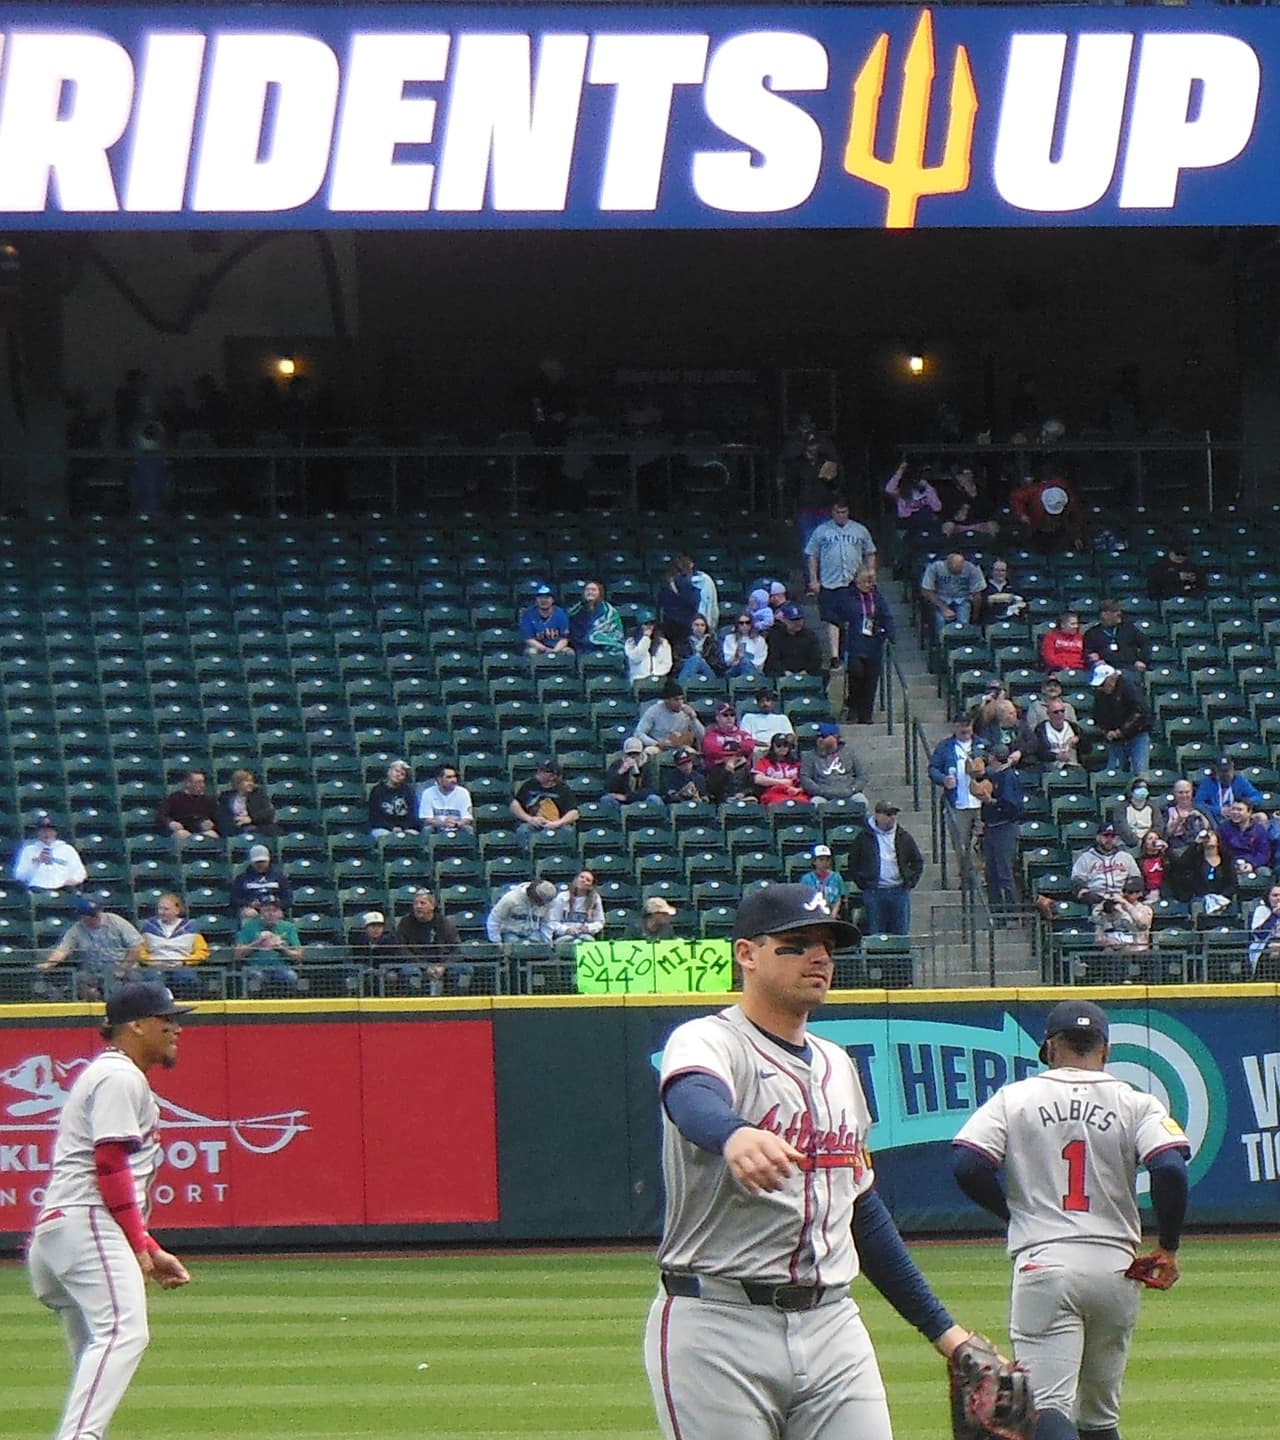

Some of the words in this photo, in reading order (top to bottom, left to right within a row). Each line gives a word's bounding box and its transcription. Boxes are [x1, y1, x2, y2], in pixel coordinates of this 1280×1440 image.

[0, 30, 830, 212] RIDENTS
[993, 31, 1262, 211] UP
[579, 944, 653, 978] JULIO
[657, 941, 731, 976] MITCH
[594, 966, 635, 993] 44
[684, 965, 709, 992] 17
[1037, 1098, 1118, 1133] ALBIES
[1061, 1139, 1090, 1212] 1
